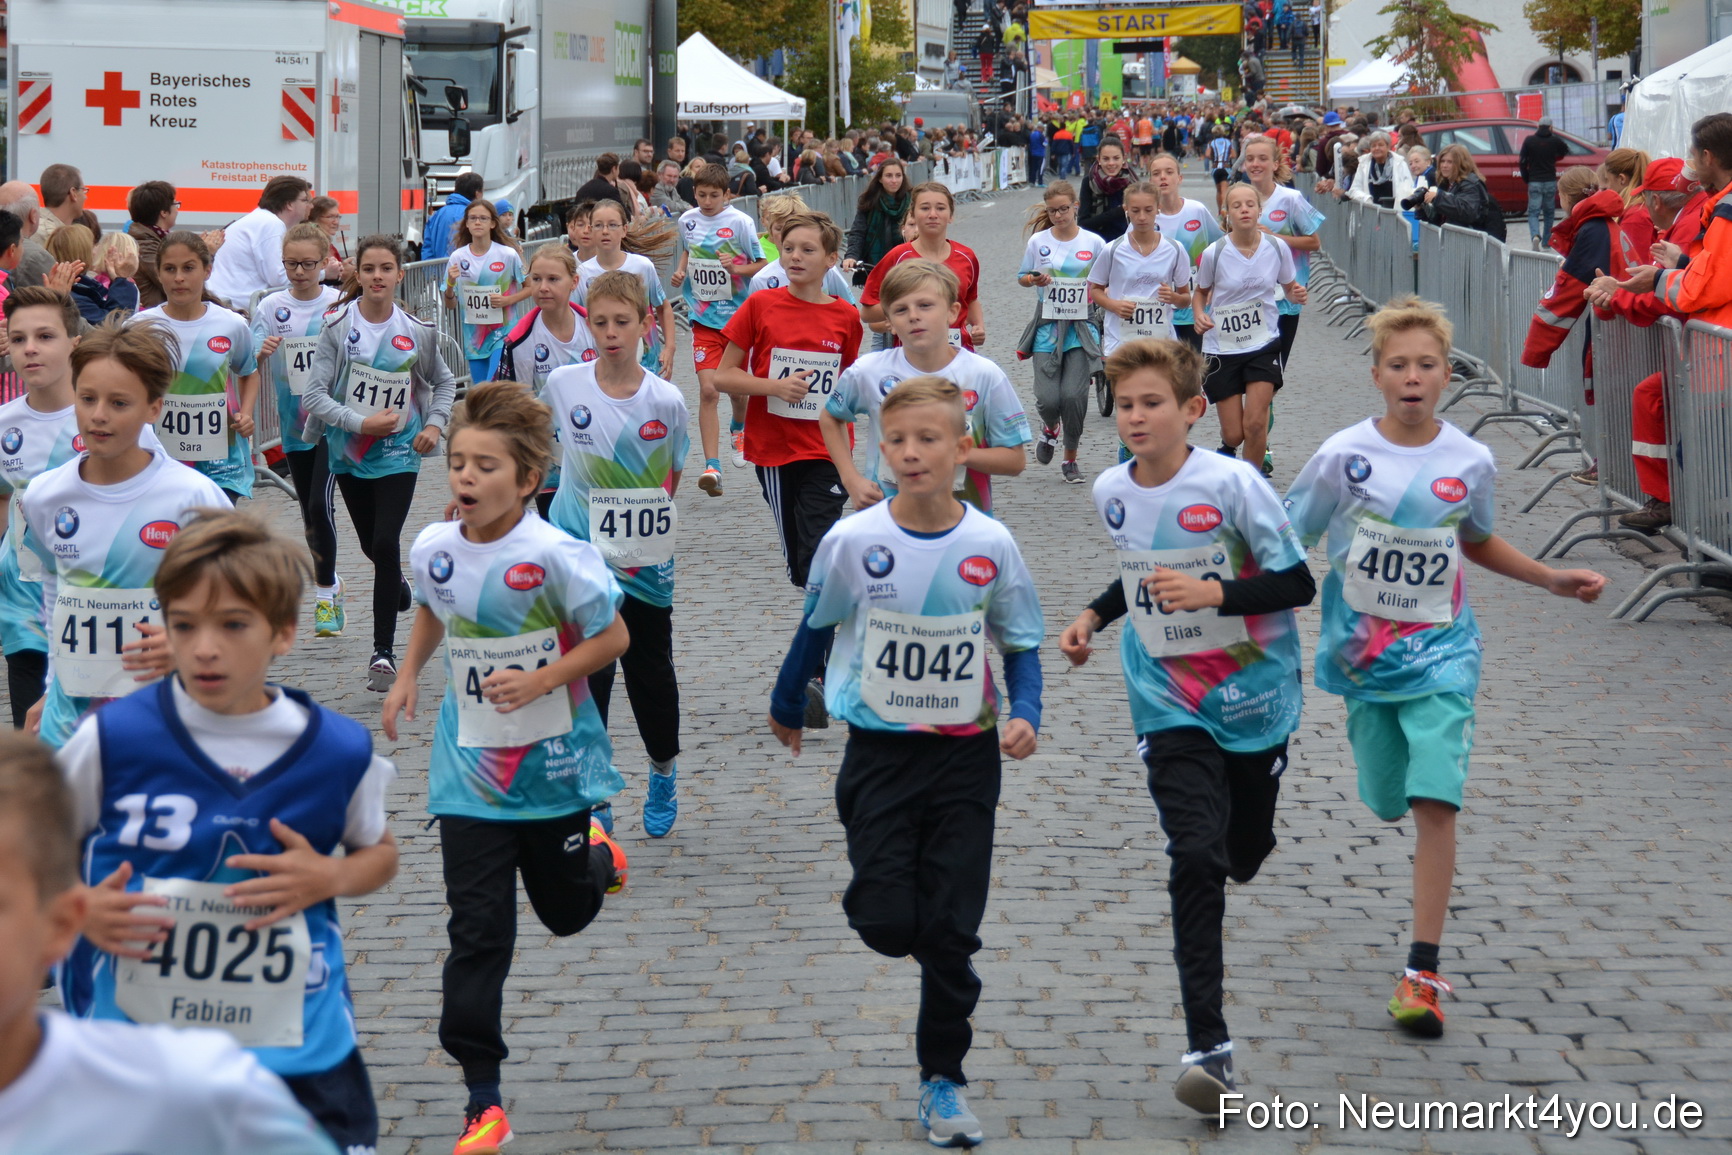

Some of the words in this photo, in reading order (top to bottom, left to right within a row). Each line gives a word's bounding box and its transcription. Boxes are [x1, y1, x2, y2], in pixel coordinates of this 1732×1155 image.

[1097, 13, 1169, 32] START
[275, 56, 309, 65] 44/54/1
[614, 26, 642, 81] BOCK
[150, 72, 251, 89] Bayerisches
[150, 93, 197, 107] Rotes
[684, 102, 750, 116] Laufsport
[150, 114, 197, 128] Kreuz
[201, 160, 307, 171] Katastrophenschutz
[211, 172, 257, 182] Freistaat
[693, 269, 727, 285] 4003
[700, 288, 717, 296] David
[1048, 287, 1085, 303] 4037
[467, 295, 497, 310] 404
[1221, 310, 1262, 333] 4034
[286, 342, 307, 350] PARTL
[1236, 334, 1252, 343] Anna
[772, 354, 797, 365] PARTL
[798, 358, 831, 367] Neumarkt
[351, 368, 372, 380] PARTL
[373, 376, 405, 386] Neumarkt
[777, 367, 833, 394] 426
[352, 381, 406, 410] 4114
[180, 400, 216, 409] Neumarkt
[162, 410, 222, 435] 4019
[179, 441, 202, 452] Sara
[1436, 482, 1465, 497] Hervis
[592, 496, 622, 504] PARTL
[624, 496, 665, 505] Neumarkt
[599, 506, 671, 538] 4105
[1183, 511, 1218, 525] Hervis
[146, 527, 177, 543] Hervi
[1357, 526, 1390, 544] PARTL
[1392, 535, 1443, 548] Neumarkt
[1121, 561, 1152, 572] PARTL
[1357, 547, 1449, 586] 4032
[57, 595, 84, 609] PARTL
[87, 599, 144, 610] Neumarkt
[1377, 591, 1418, 609] Kilian
[869, 618, 908, 635] PARTL
[911, 626, 967, 638] Neumarkt
[1164, 624, 1203, 641] Elias
[451, 648, 481, 660] PARTL
[483, 644, 538, 660] Neumarkt
[875, 640, 974, 682] 4042
[885, 690, 959, 709] Jonathan
[1218, 683, 1246, 702] 16.
[1221, 687, 1278, 713] Neumarkter
[1222, 701, 1269, 723] Stadtlauf
[543, 738, 569, 757] 16.
[114, 793, 198, 851] 13
[141, 921, 295, 983] 4025
[171, 996, 252, 1024] Fabian
